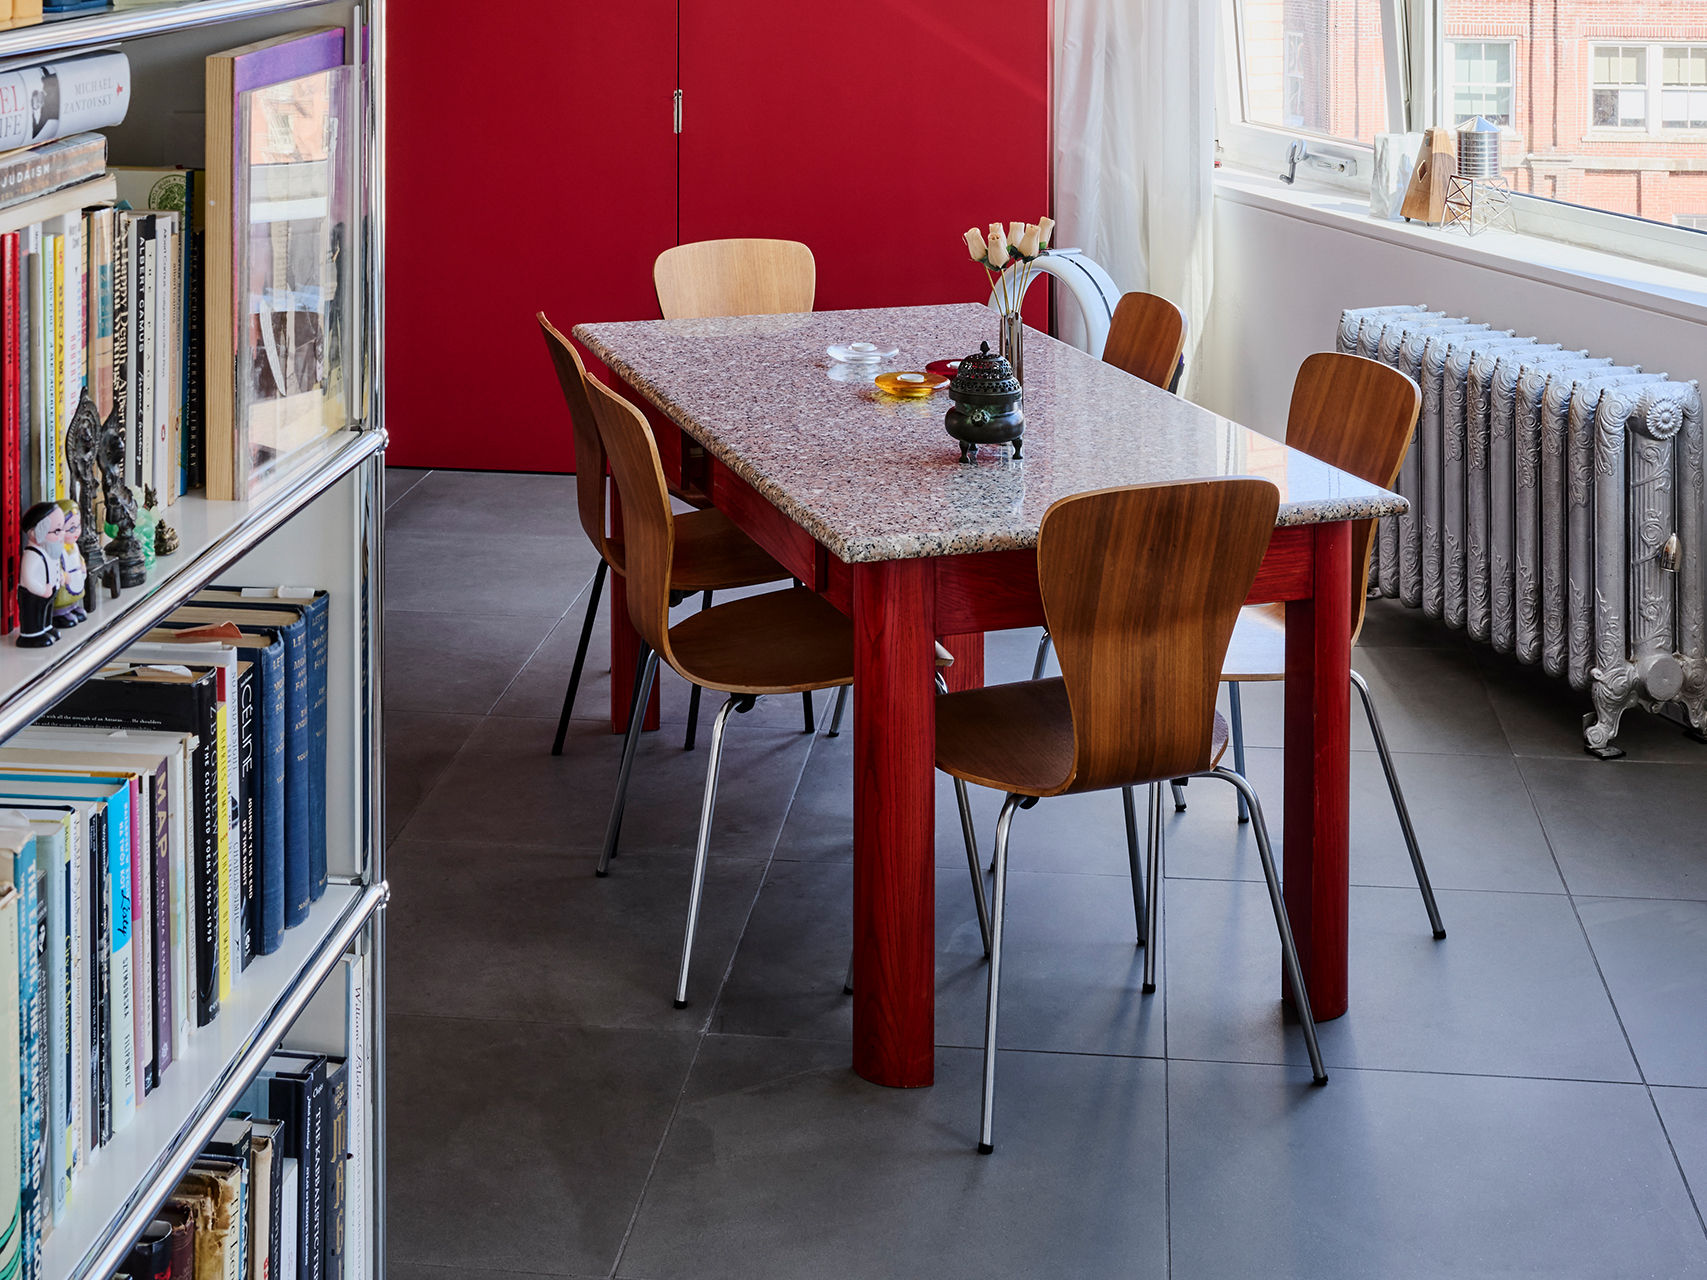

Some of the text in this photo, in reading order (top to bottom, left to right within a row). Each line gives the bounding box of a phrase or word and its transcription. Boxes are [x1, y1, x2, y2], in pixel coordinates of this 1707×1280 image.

[75, 77, 114, 96] MICHAEL
[2, 163, 51, 188] JUDAISM
[118, 246, 129, 424] Happy Death Albert
[232, 672, 238, 688] NO
[242, 683, 254, 779] CÉLINE
[157, 771, 168, 858] MAP
[117, 888, 132, 937] Listy
[28, 859, 42, 1239] THE EARTH, THE TEMPLE, AND THE
[42, 990, 50, 1068] INTERRUPTED
[122, 957, 132, 1088] SZYMBORSKA FILIPOWICZ
[354, 986, 364, 1100] William Blake
[229, 1189, 240, 1238] The
